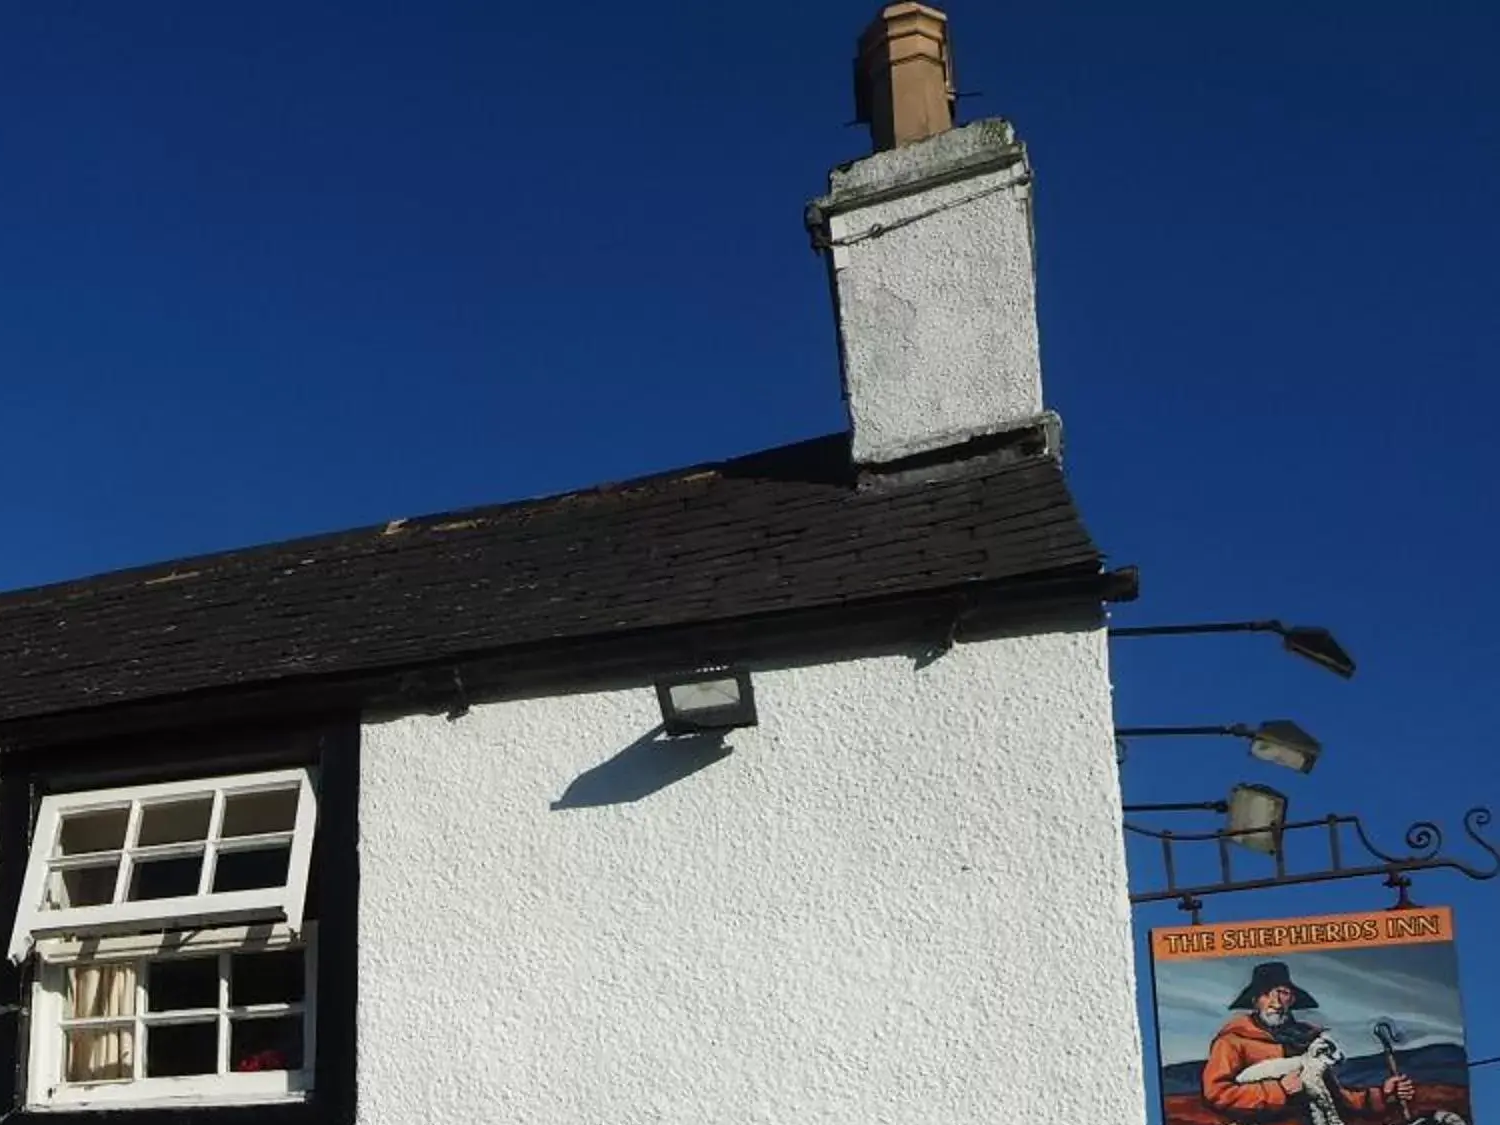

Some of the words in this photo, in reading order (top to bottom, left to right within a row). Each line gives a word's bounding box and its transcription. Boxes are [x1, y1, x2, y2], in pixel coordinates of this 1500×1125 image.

[1164, 932, 1216, 954] THE
[1222, 920, 1378, 950] SHEPHERDS
[1386, 915, 1441, 939] INN
